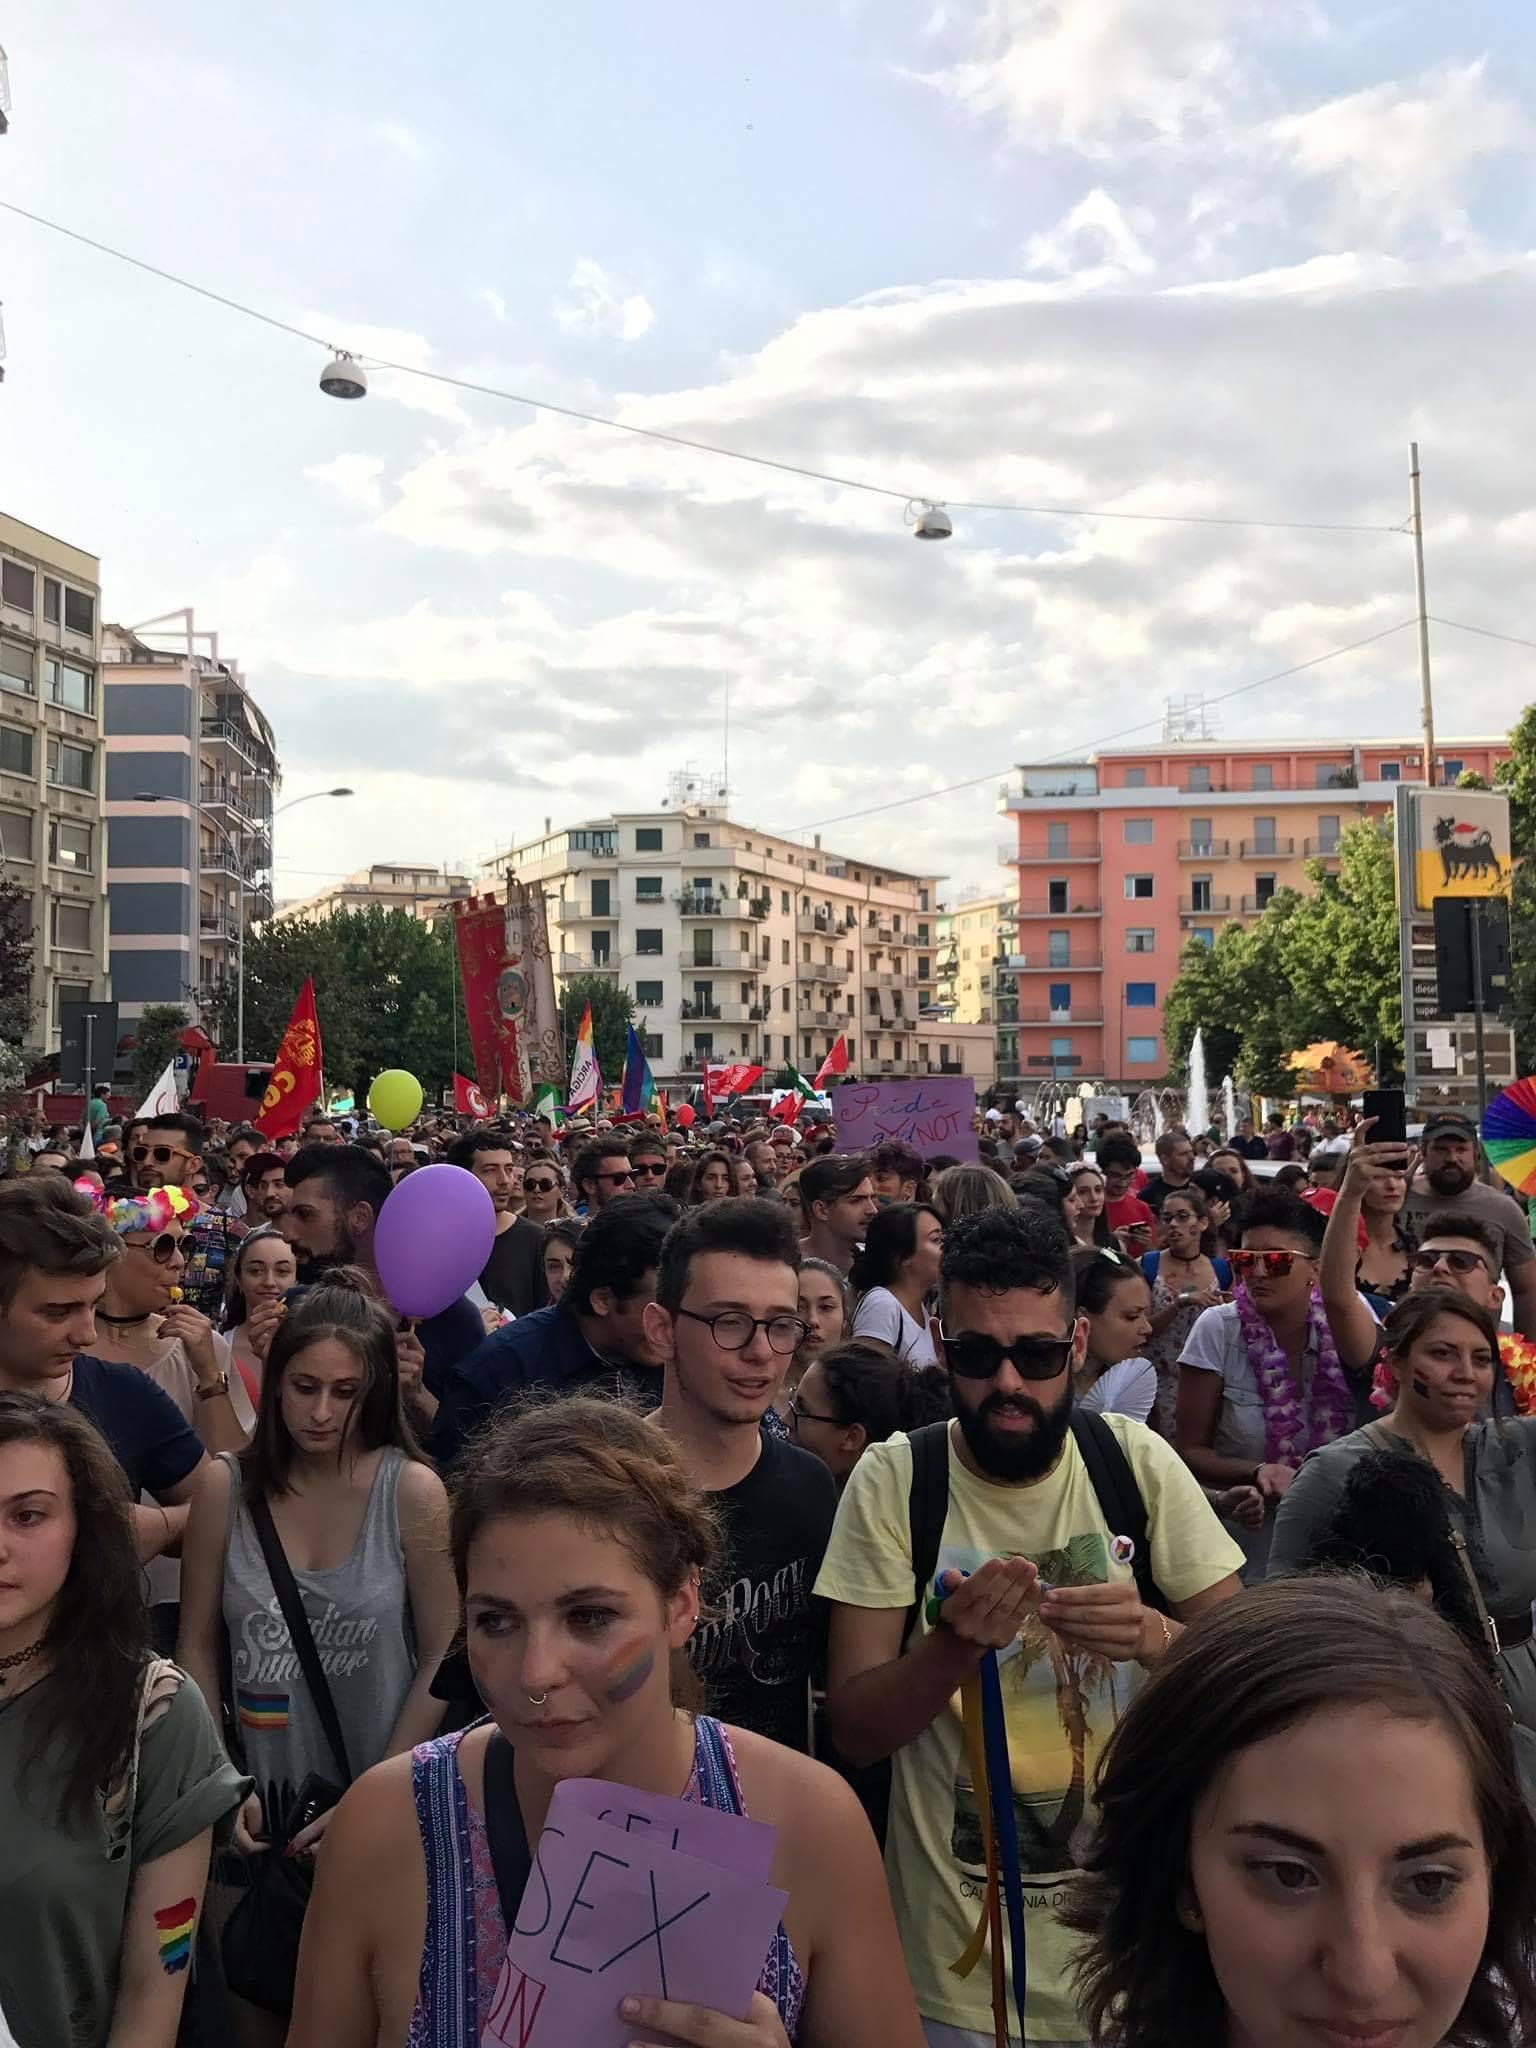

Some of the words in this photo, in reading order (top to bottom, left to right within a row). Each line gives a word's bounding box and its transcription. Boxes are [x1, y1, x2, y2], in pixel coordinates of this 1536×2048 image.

[1415, 984, 1438, 995] diesel
[1416, 1006, 1438, 1016] super
[175, 1056, 184, 1068] P
[257, 1588, 378, 1651] Idian
[512, 1827, 711, 2001] SEX
